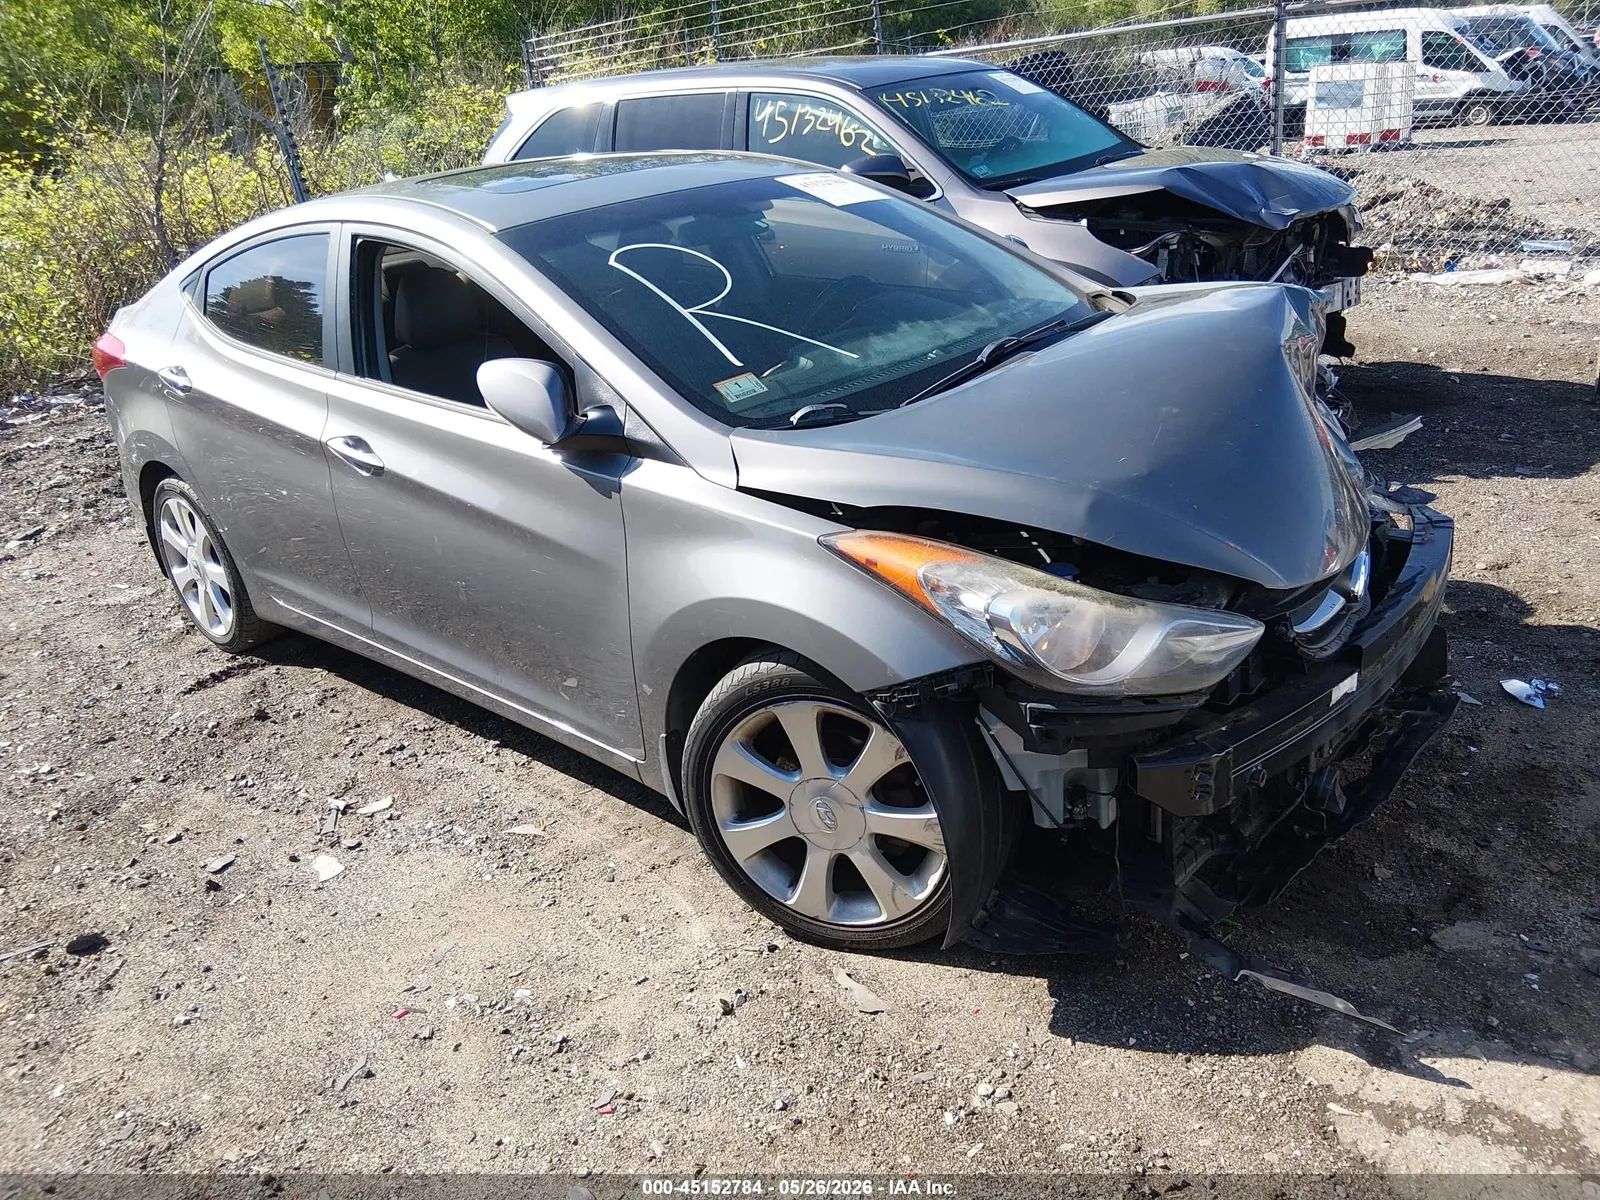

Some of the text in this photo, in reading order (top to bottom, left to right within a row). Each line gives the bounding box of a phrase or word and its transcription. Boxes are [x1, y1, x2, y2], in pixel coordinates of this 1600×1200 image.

[755, 98, 877, 156] 45132462
[608, 242, 859, 367] R
[745, 677, 791, 697] LS388
